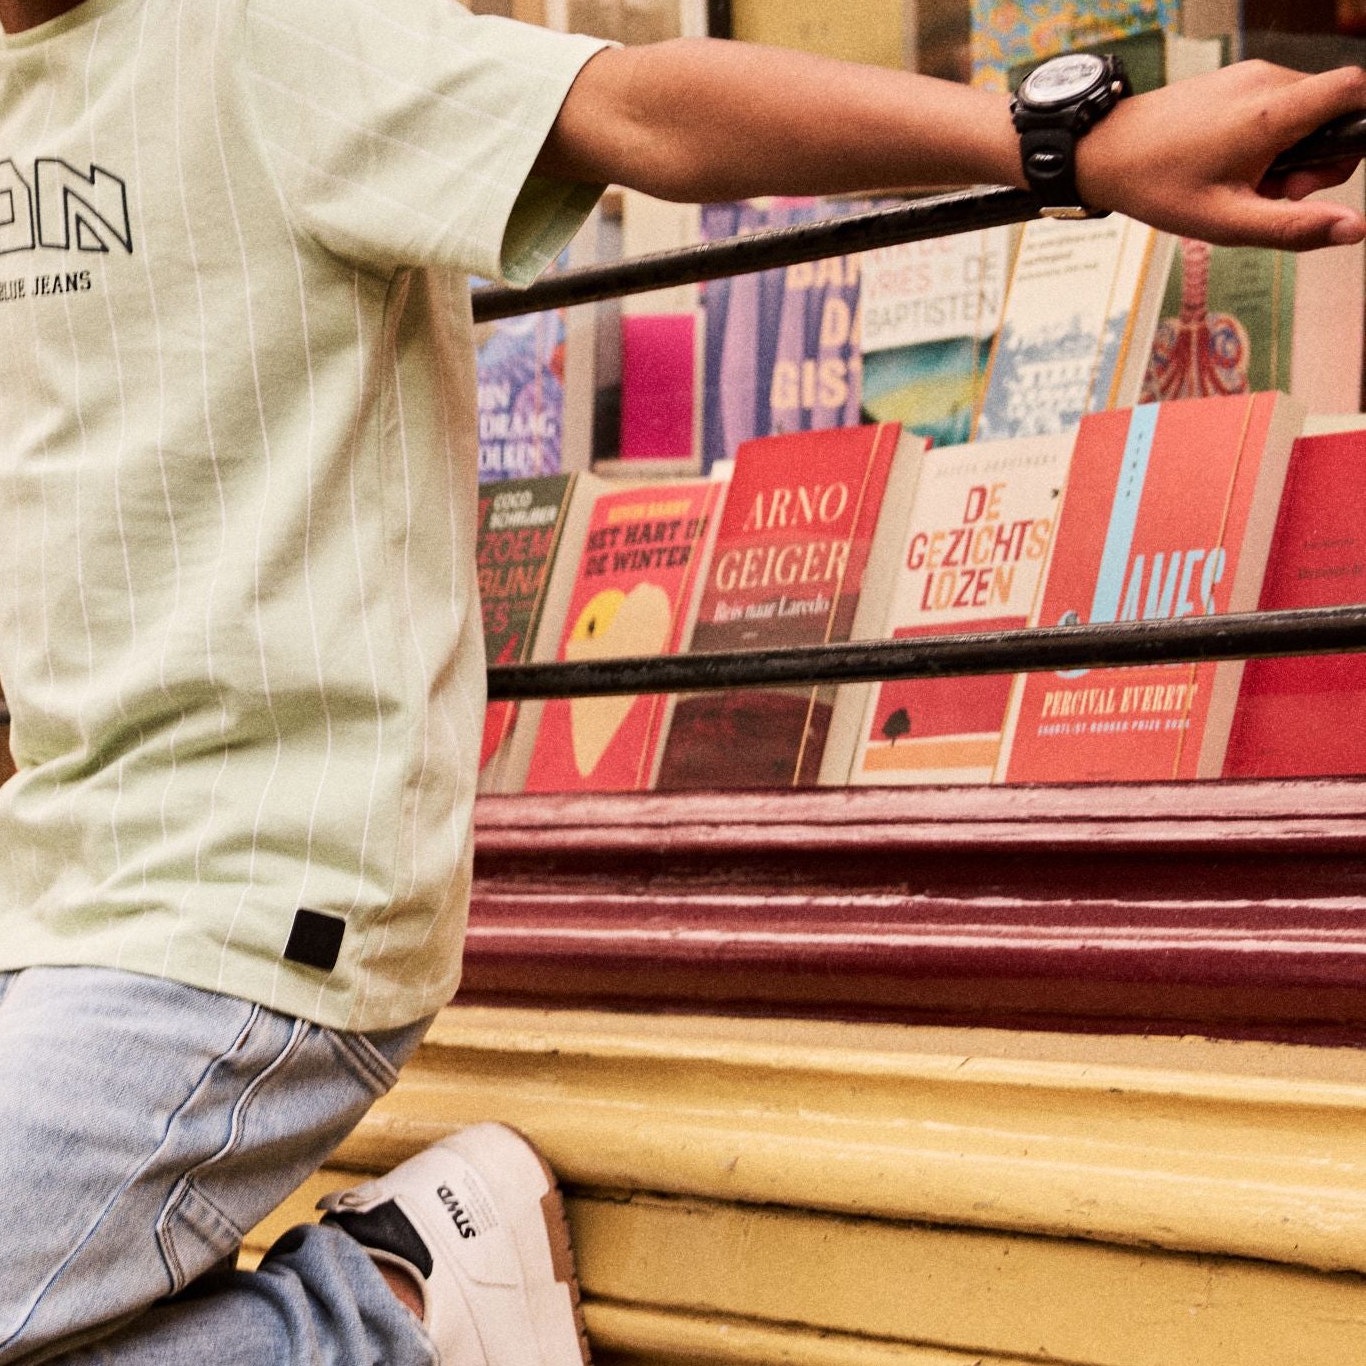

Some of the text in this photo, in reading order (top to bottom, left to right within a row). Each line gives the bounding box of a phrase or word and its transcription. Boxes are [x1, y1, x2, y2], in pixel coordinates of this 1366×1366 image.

[31, 270, 92, 297] JEANS
[742, 482, 849, 533] ARNO
[963, 482, 1007, 524] DE
[624, 519, 681, 546] HART
[906, 517, 1052, 571] GEZICHTS
[611, 545, 693, 573] WINTER
[715, 540, 852, 592] GEIGER
[920, 564, 1015, 612] LOZEN
[1041, 683, 1199, 719] PERCIVAL EVERETT
